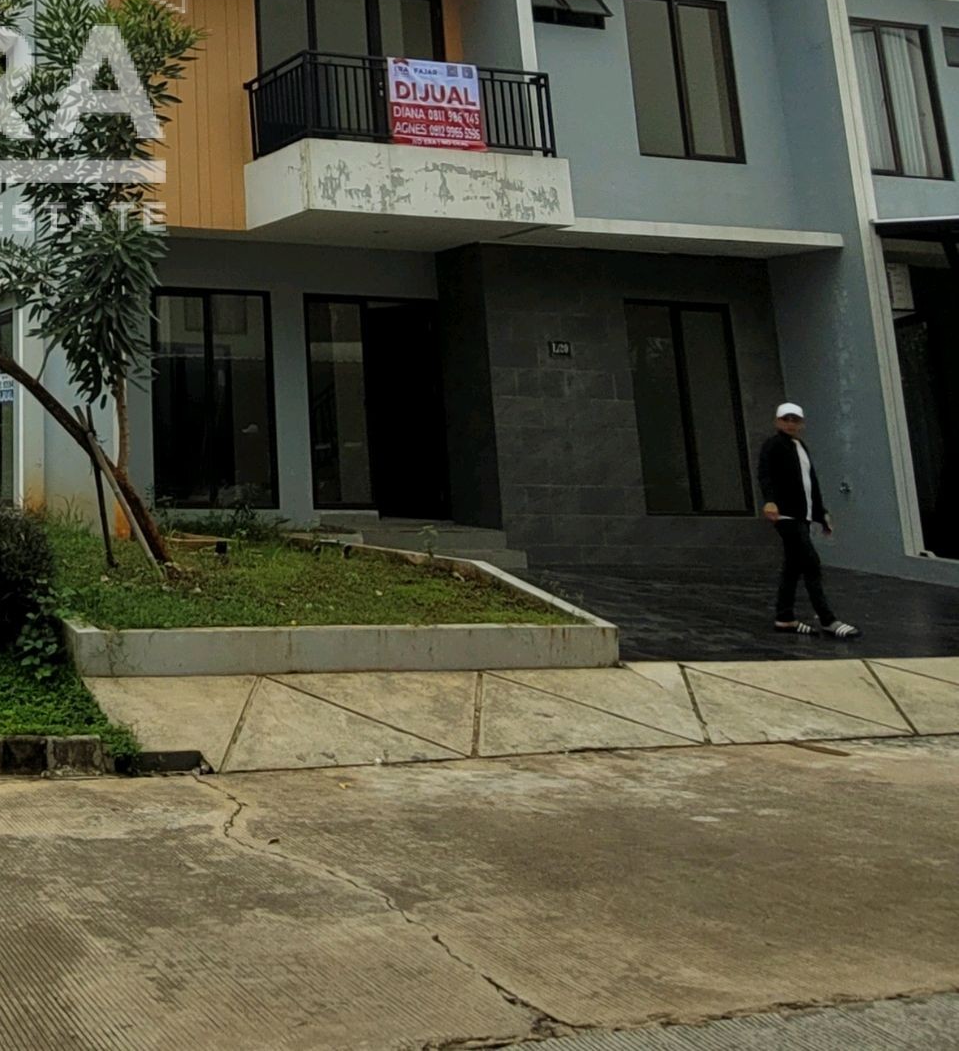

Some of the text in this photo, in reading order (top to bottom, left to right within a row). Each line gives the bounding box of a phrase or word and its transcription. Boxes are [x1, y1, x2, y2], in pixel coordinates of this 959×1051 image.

[395, 80, 476, 106] DIJUAL
[393, 106, 426, 119] DIANA
[428, 109, 445, 121] 0811
[394, 121, 427, 134] AGNES
